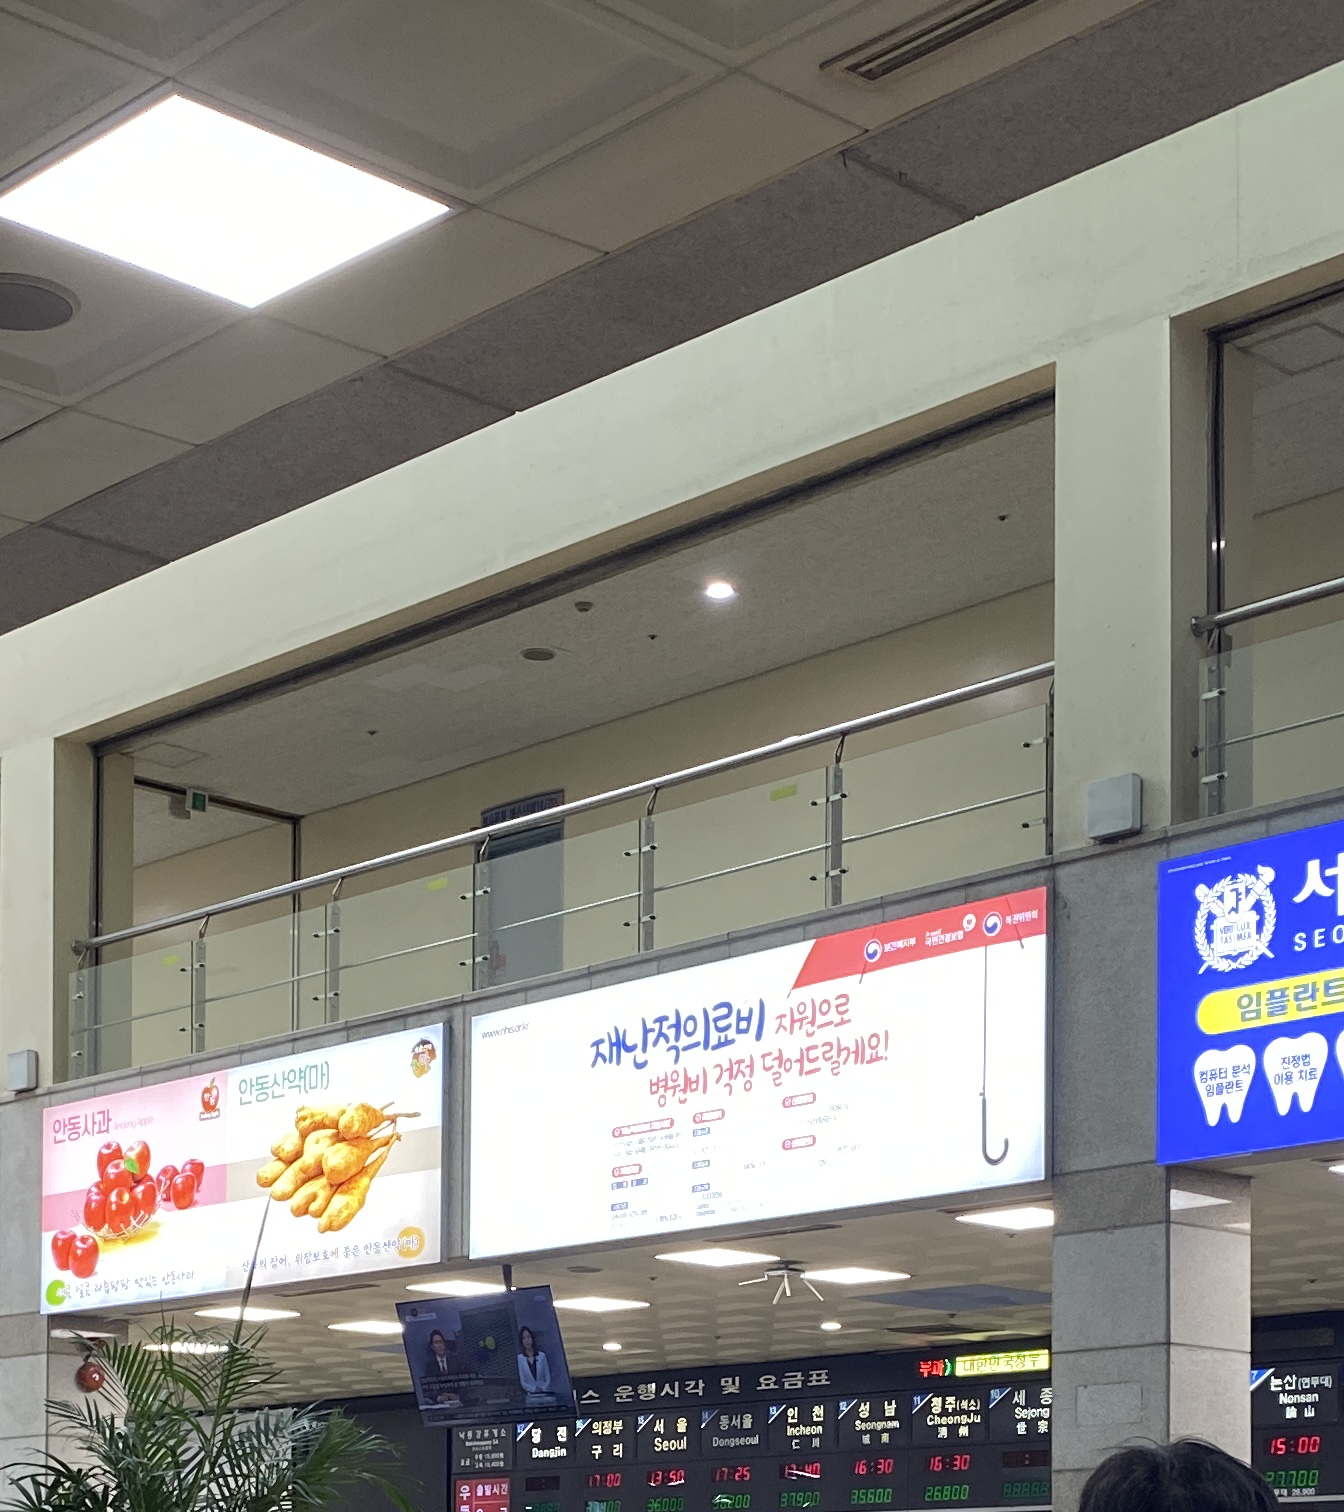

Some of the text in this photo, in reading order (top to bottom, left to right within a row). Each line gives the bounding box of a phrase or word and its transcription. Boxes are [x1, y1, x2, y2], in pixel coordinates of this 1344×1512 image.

[589, 993, 853, 1071] 재난적의료비 지원으로
[648, 1027, 890, 1109] 병원비 걱정 덜어드릴게요!
[1281, 1053, 1311, 1070] 진정법
[1199, 1063, 1251, 1084] 컴퓨터 분석
[1274, 1067, 1318, 1086] 이용 치료
[238, 1061, 330, 1106] 안동산약(마)
[1205, 1079, 1244, 1098] 임플란트
[52, 1108, 112, 1145] 안동사과
[614, 1370, 831, 1403] 운행시각 및 요금표
[1279, 1393, 1319, 1405] Nonsan
[926, 1413, 981, 1426] CheongJu
[1014, 1406, 1050, 1420] Sejong
[592, 1420, 623, 1435] 의정부
[719, 1414, 753, 1430] 동서울
[855, 1419, 900, 1432] Seongnam
[786, 1424, 823, 1437] Incheon
[654, 1436, 687, 1452] Seoul
[712, 1434, 759, 1448] Dongseoul
[1270, 1437, 1321, 1454] 15:00
[531, 1446, 567, 1458] Dangjin
[854, 1459, 894, 1475] 16:30
[929, 1455, 971, 1471] 16:30
[588, 1472, 621, 1487] 17:00
[716, 1466, 750, 1481] 17:25
[476, 1484, 508, 1497] 출발시간
